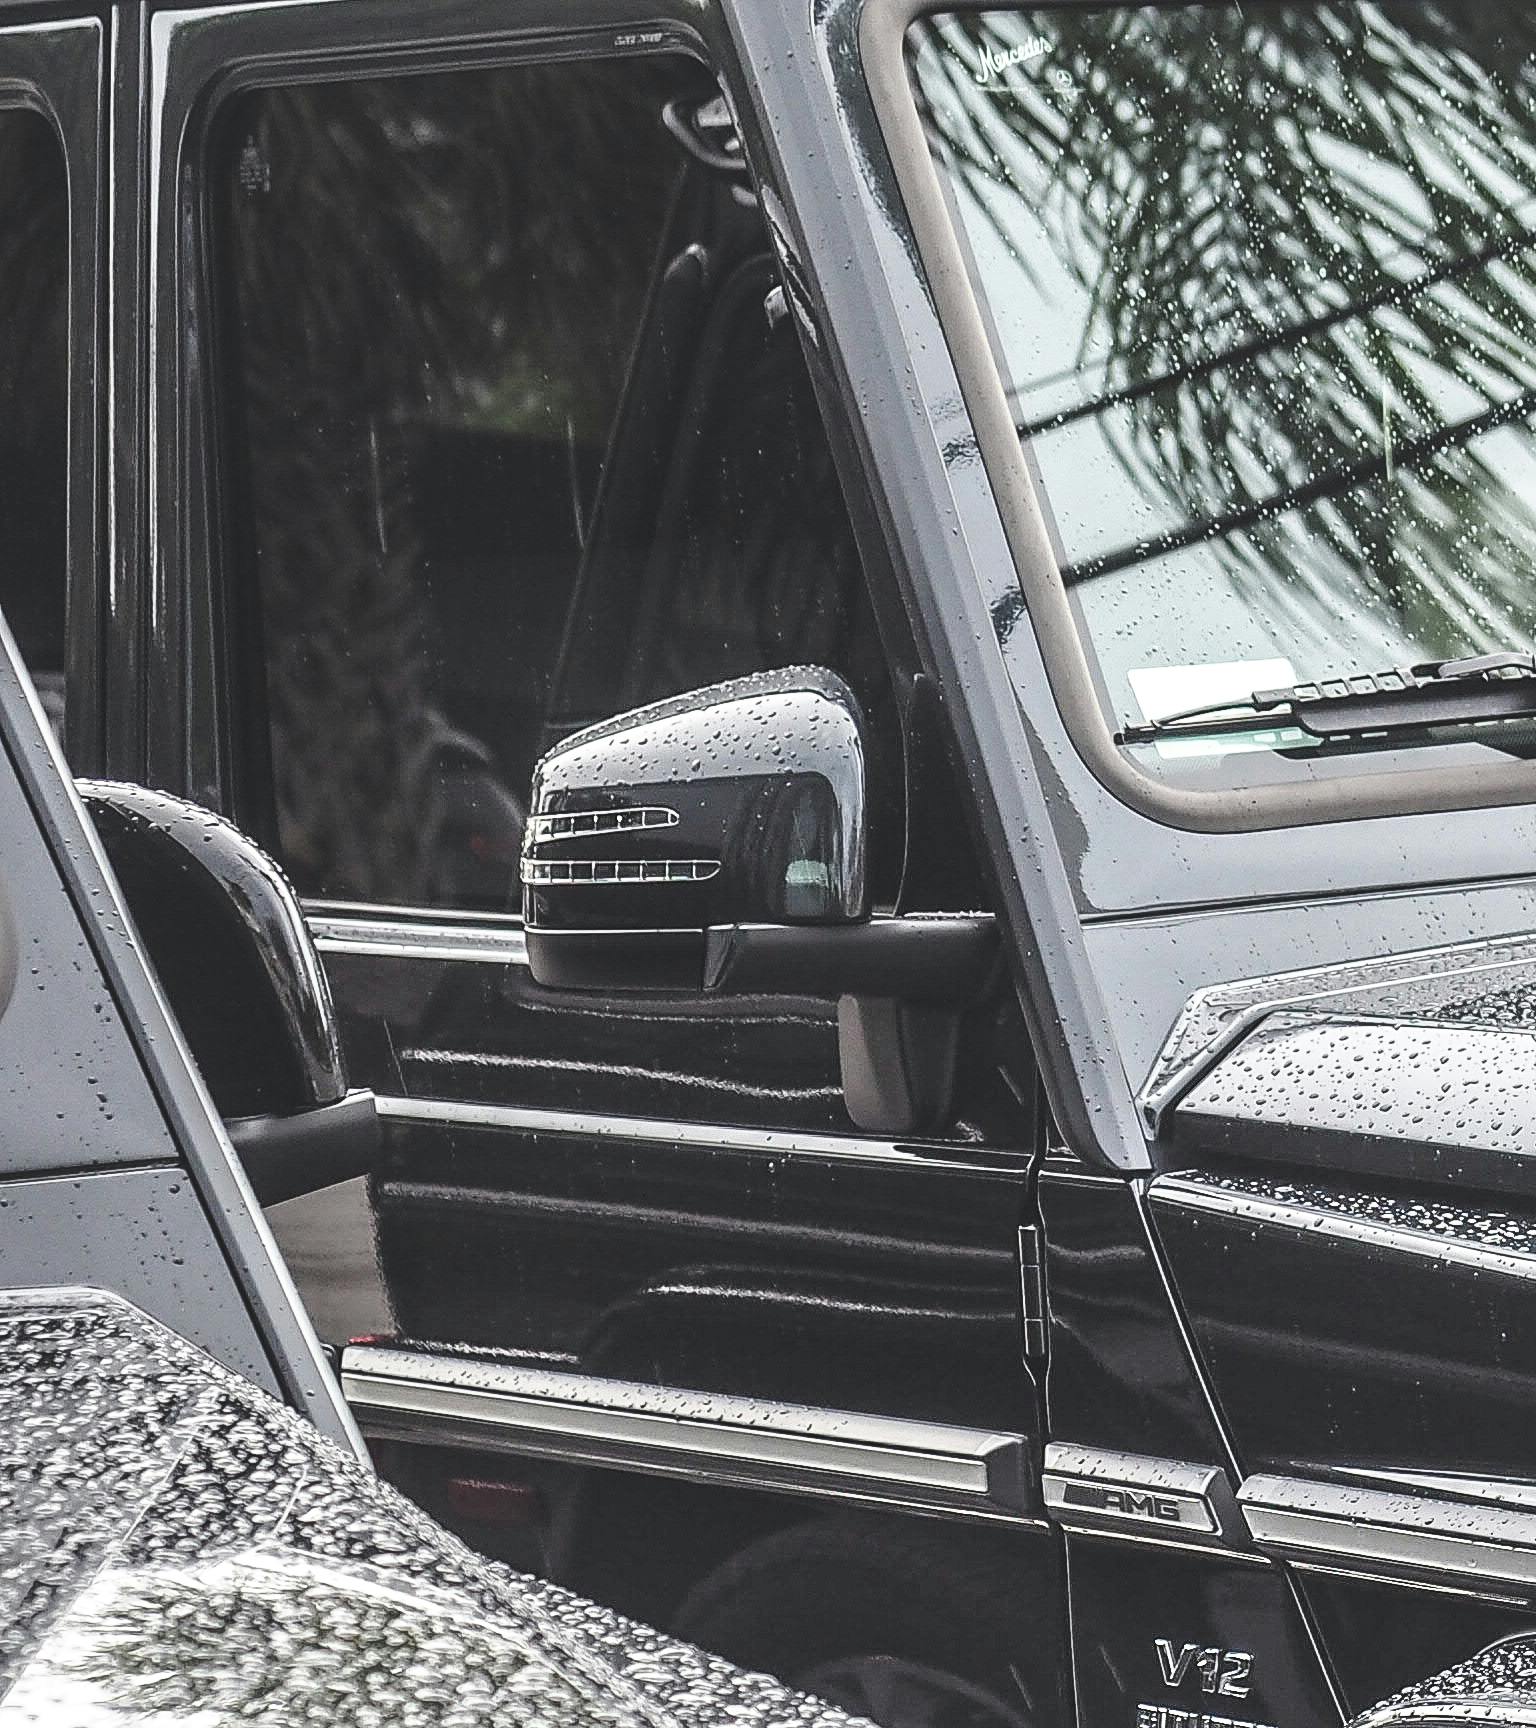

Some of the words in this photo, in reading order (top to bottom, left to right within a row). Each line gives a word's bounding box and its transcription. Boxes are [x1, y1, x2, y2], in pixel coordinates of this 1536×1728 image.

[976, 35, 1053, 83] Mercedes
[1104, 1487, 1180, 1522] AMG
[1154, 1638, 1255, 1699] V12
